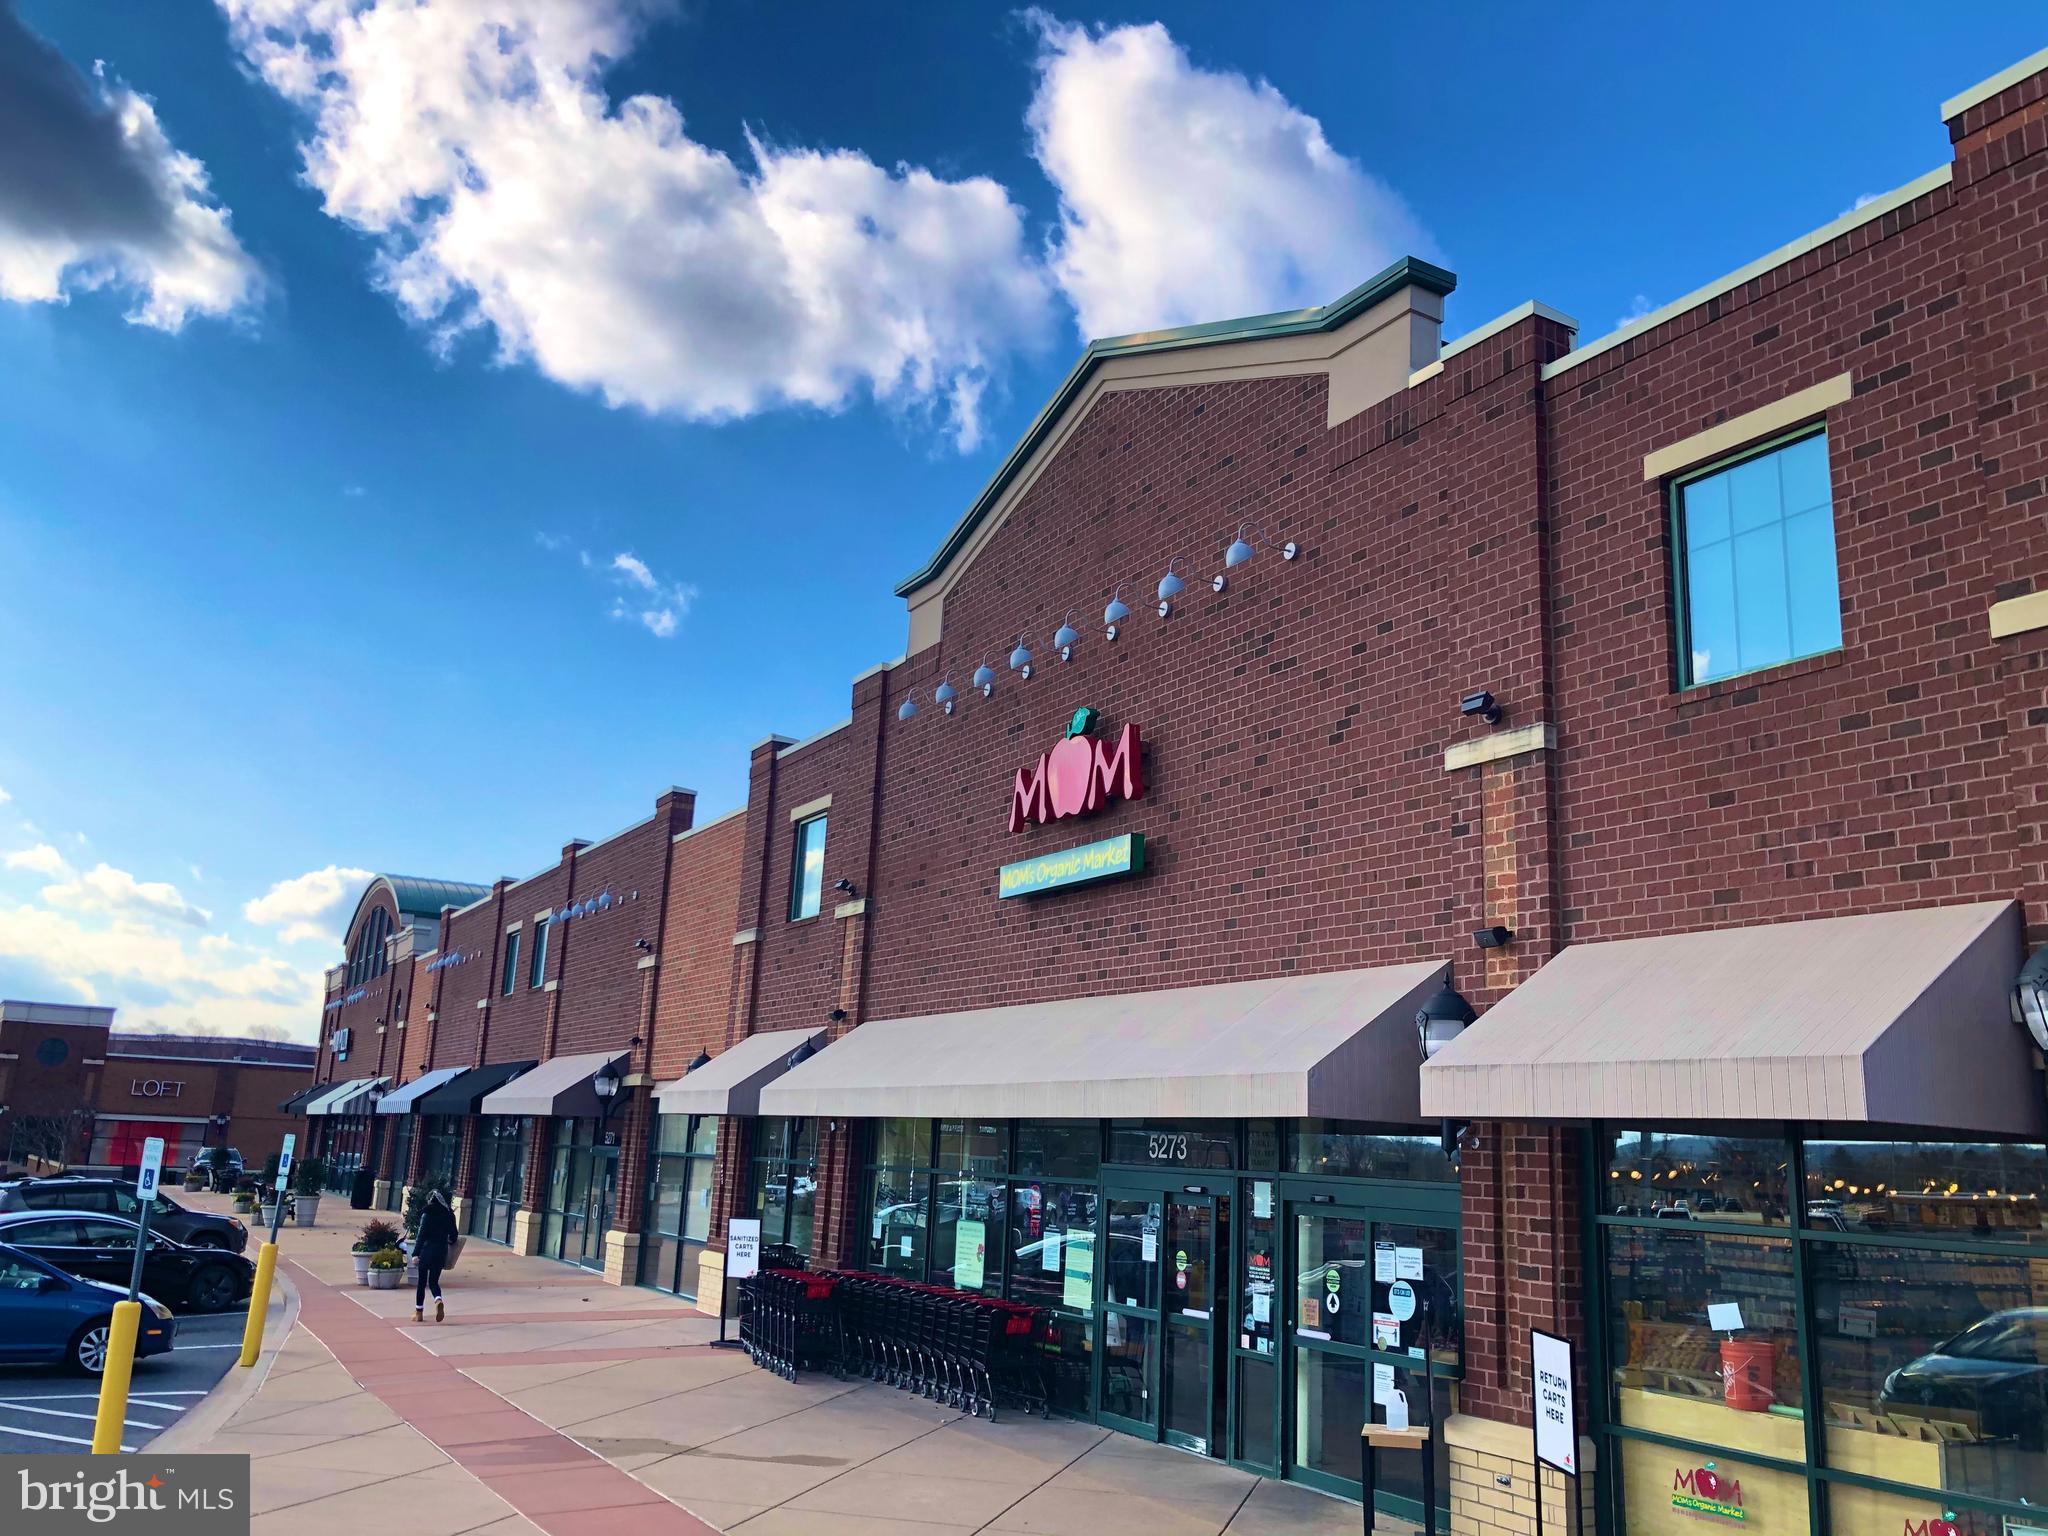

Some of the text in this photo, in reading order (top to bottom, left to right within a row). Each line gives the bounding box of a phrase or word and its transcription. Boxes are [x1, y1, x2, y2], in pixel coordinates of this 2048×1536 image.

[1008, 722, 1138, 833] MOM
[1036, 854, 1081, 884] Organic
[1083, 838, 1129, 871] Market
[131, 1079, 186, 1097] LOFT
[1148, 1134, 1187, 1160] 5273
[1539, 1370, 1568, 1391] RETURN
[1542, 1388, 1566, 1408] CARTS
[1545, 1405, 1564, 1424] HERE
[1673, 1468, 1743, 1507] MOM
[1692, 1499, 1717, 1512] Organic
[1717, 1505, 1744, 1519] Market
